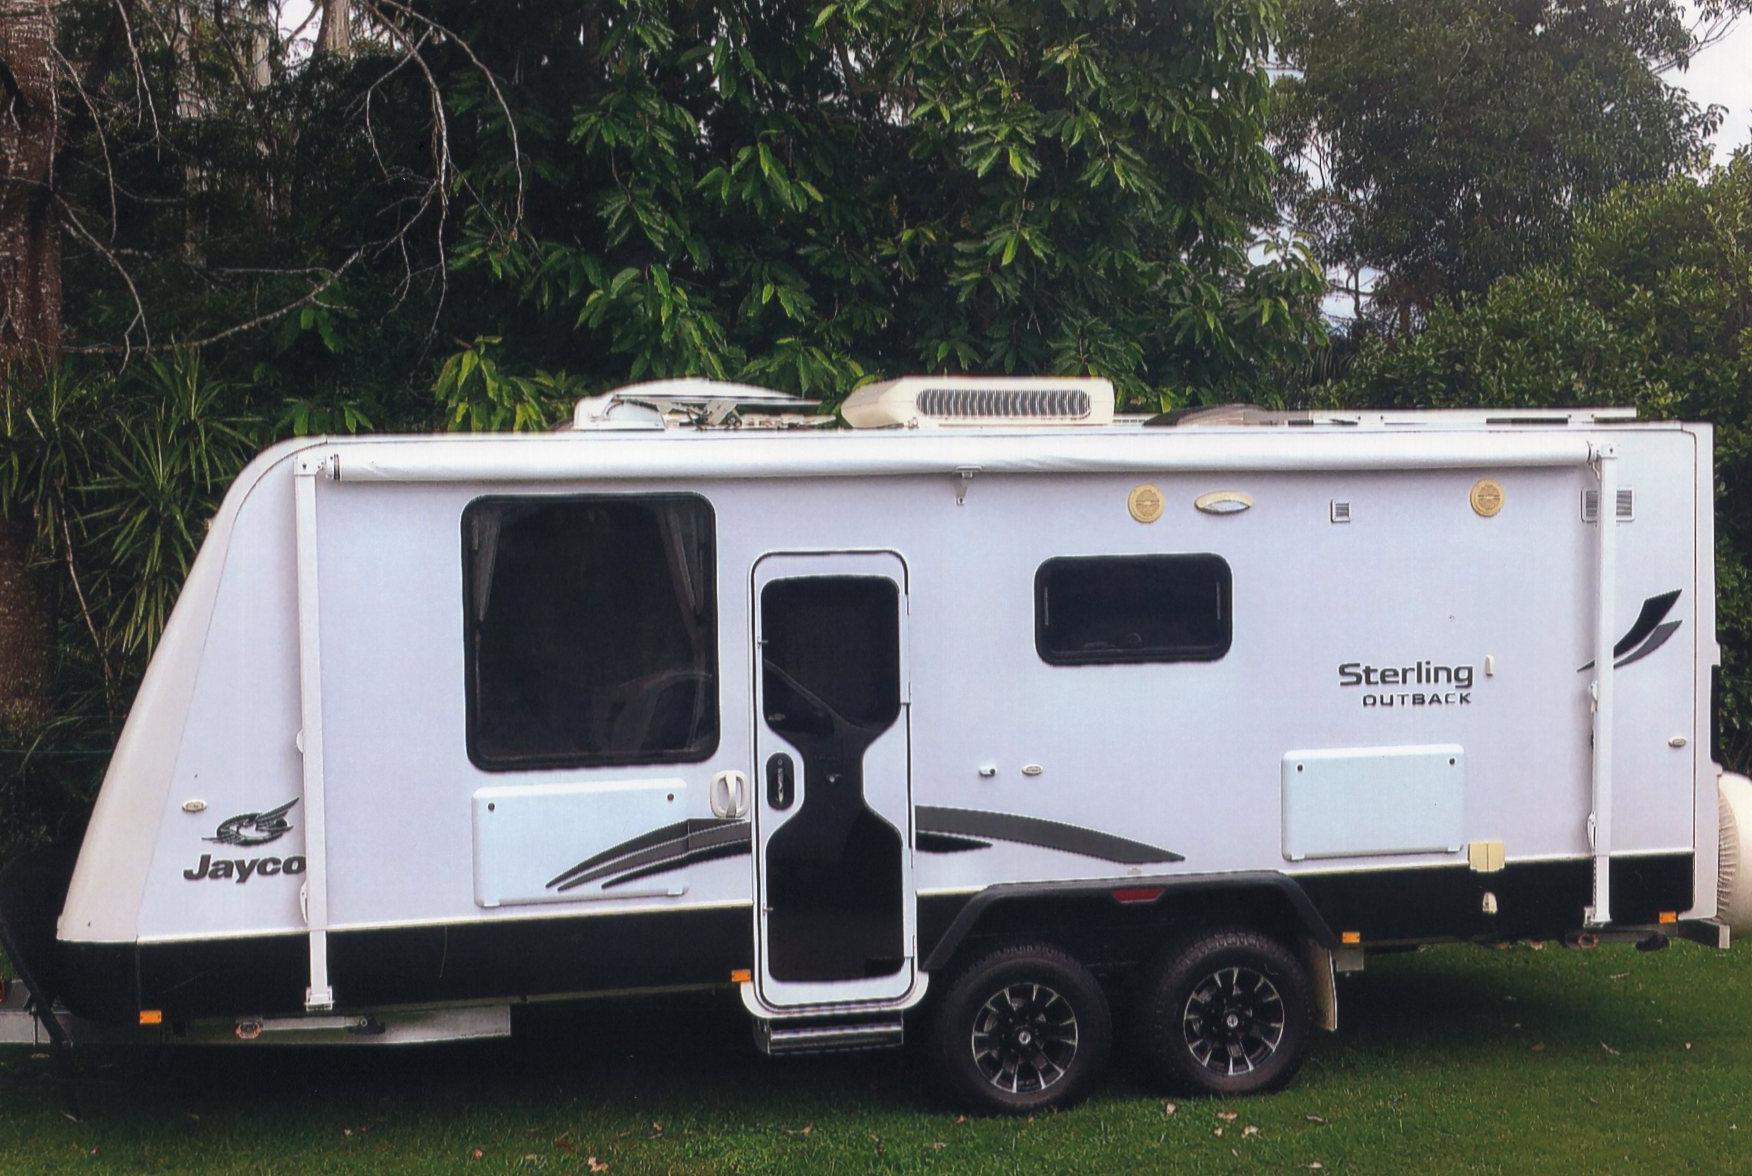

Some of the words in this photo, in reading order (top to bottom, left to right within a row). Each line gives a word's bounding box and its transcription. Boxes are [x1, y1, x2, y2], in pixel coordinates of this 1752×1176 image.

[1338, 660, 1474, 689] Sterling
[1362, 692, 1472, 706] OUTBACK
[183, 854, 307, 884] Jayco
